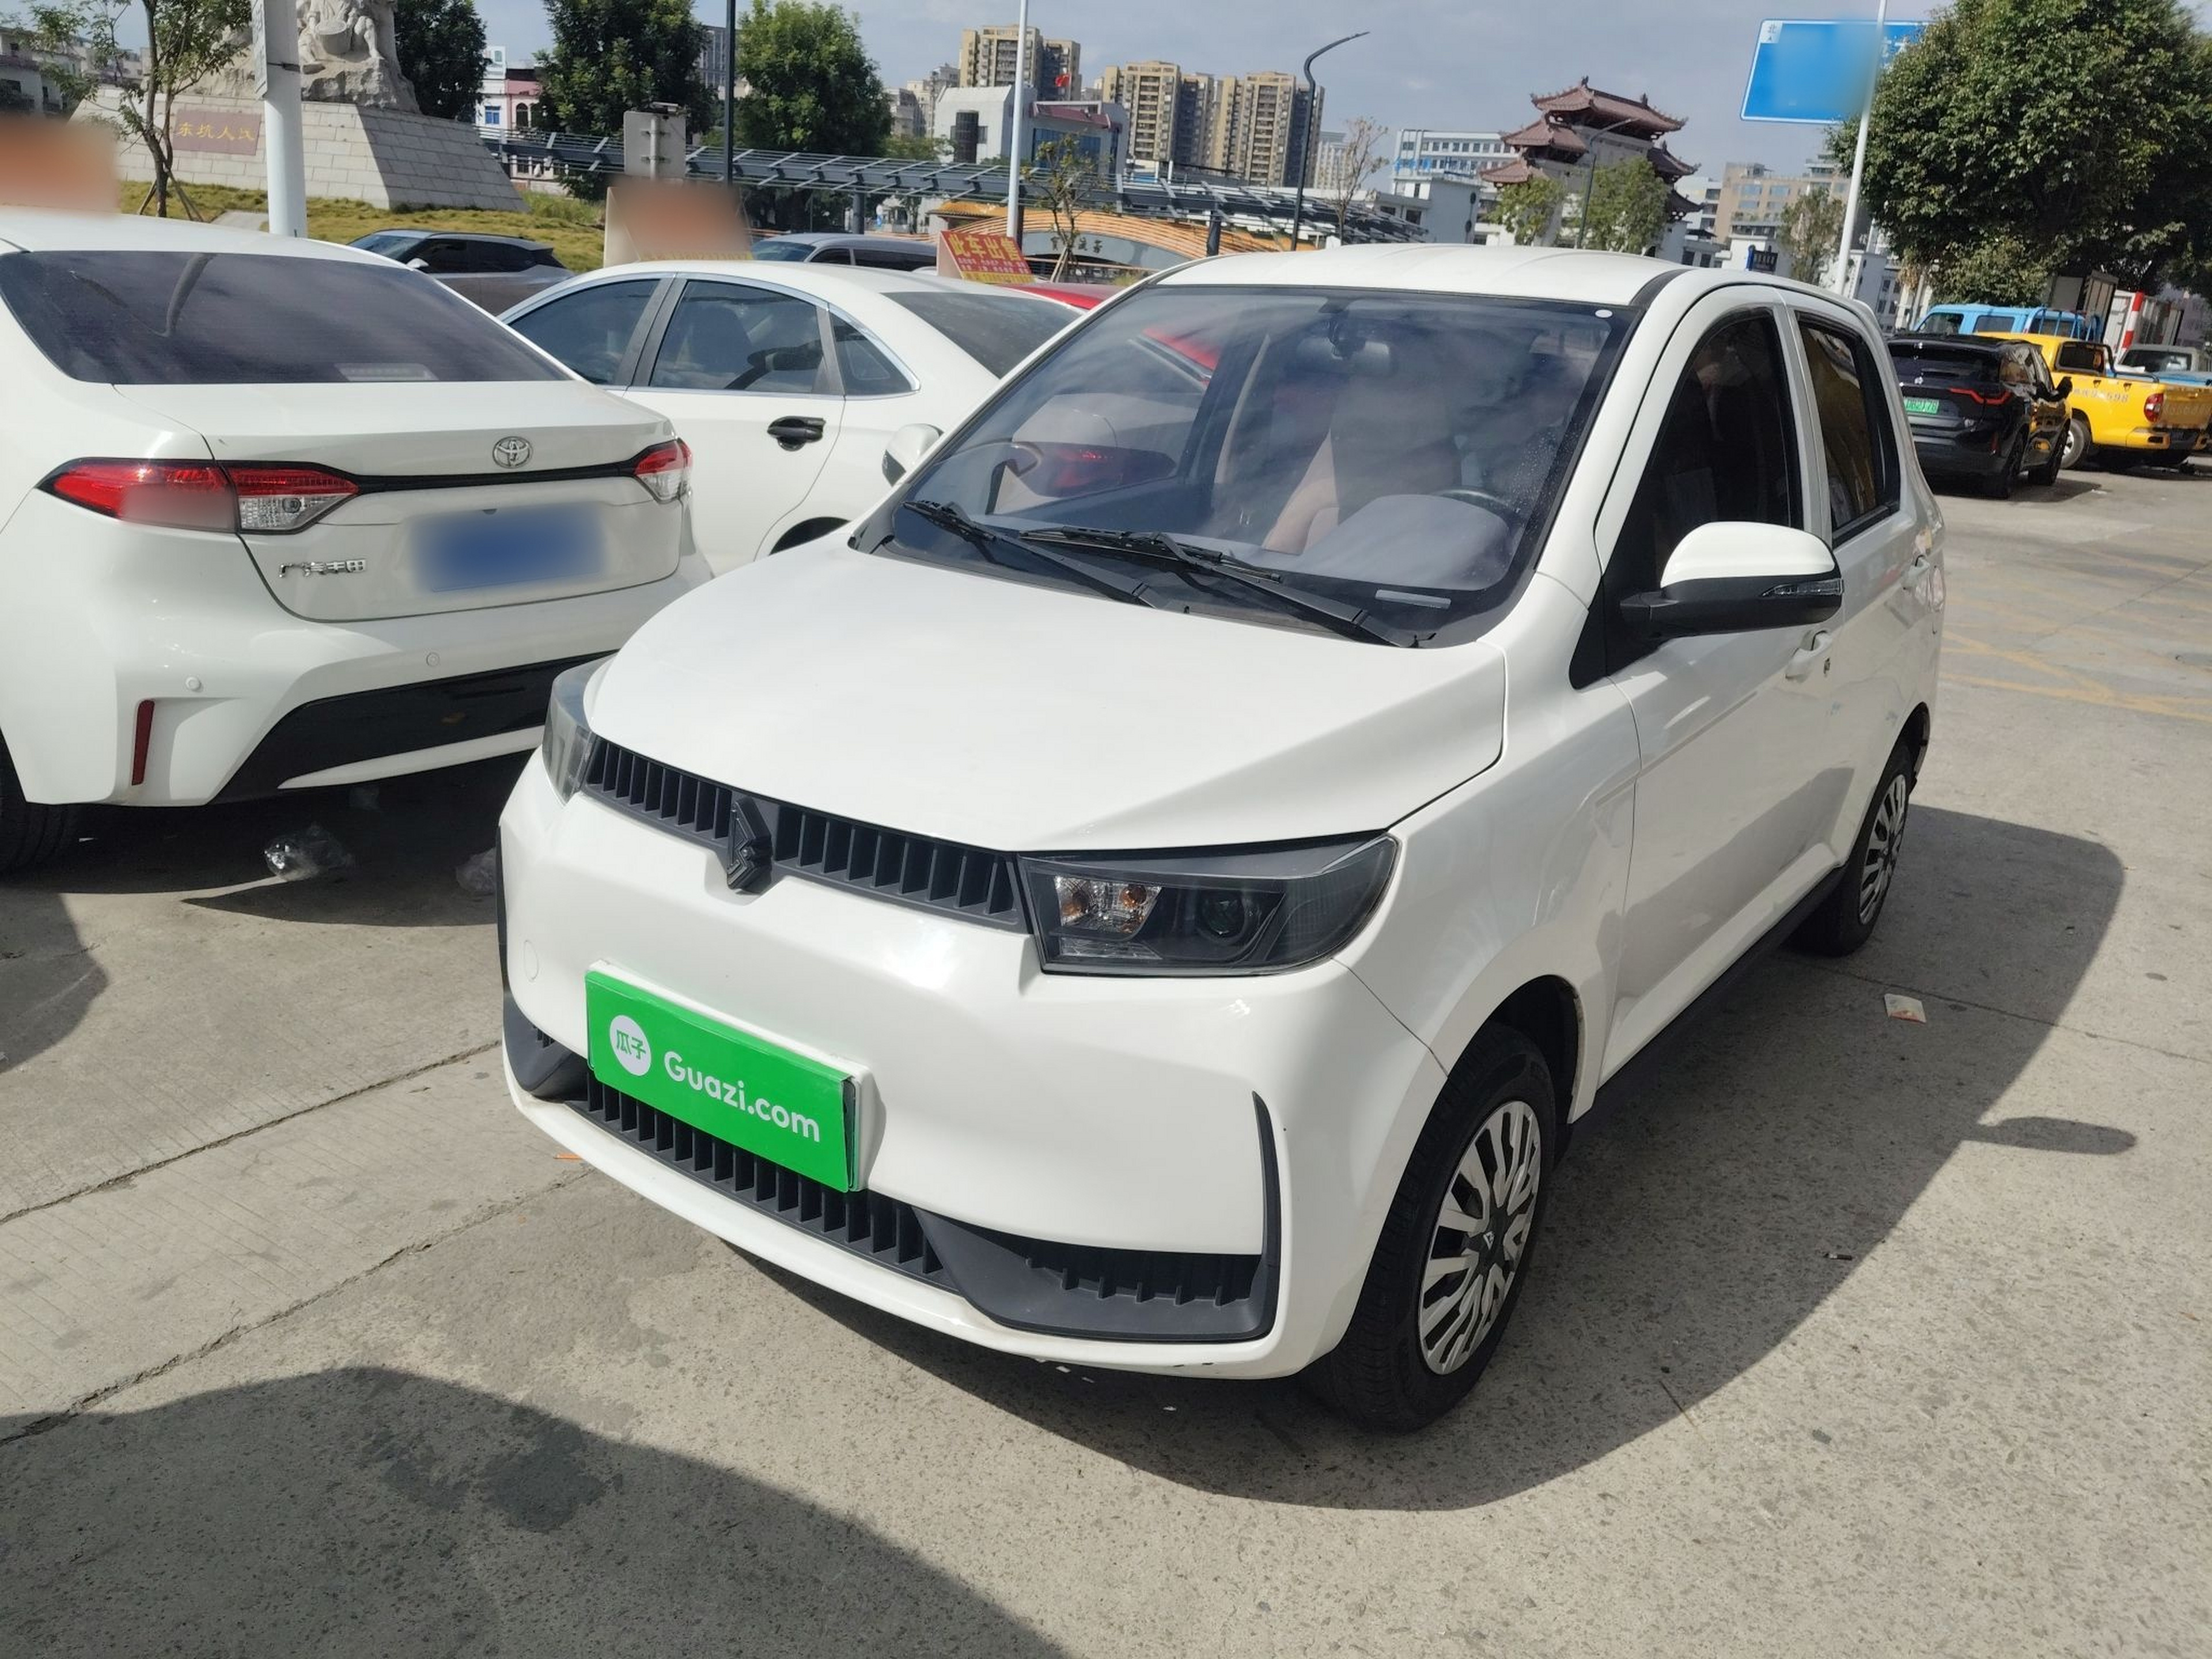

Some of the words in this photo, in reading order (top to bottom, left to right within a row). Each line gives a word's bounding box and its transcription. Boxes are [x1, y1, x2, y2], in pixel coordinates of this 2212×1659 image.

[948, 233, 1021, 261] 此车出售
[616, 1029, 646, 1060] 瓜子
[664, 1051, 820, 1142] Guazi.com
